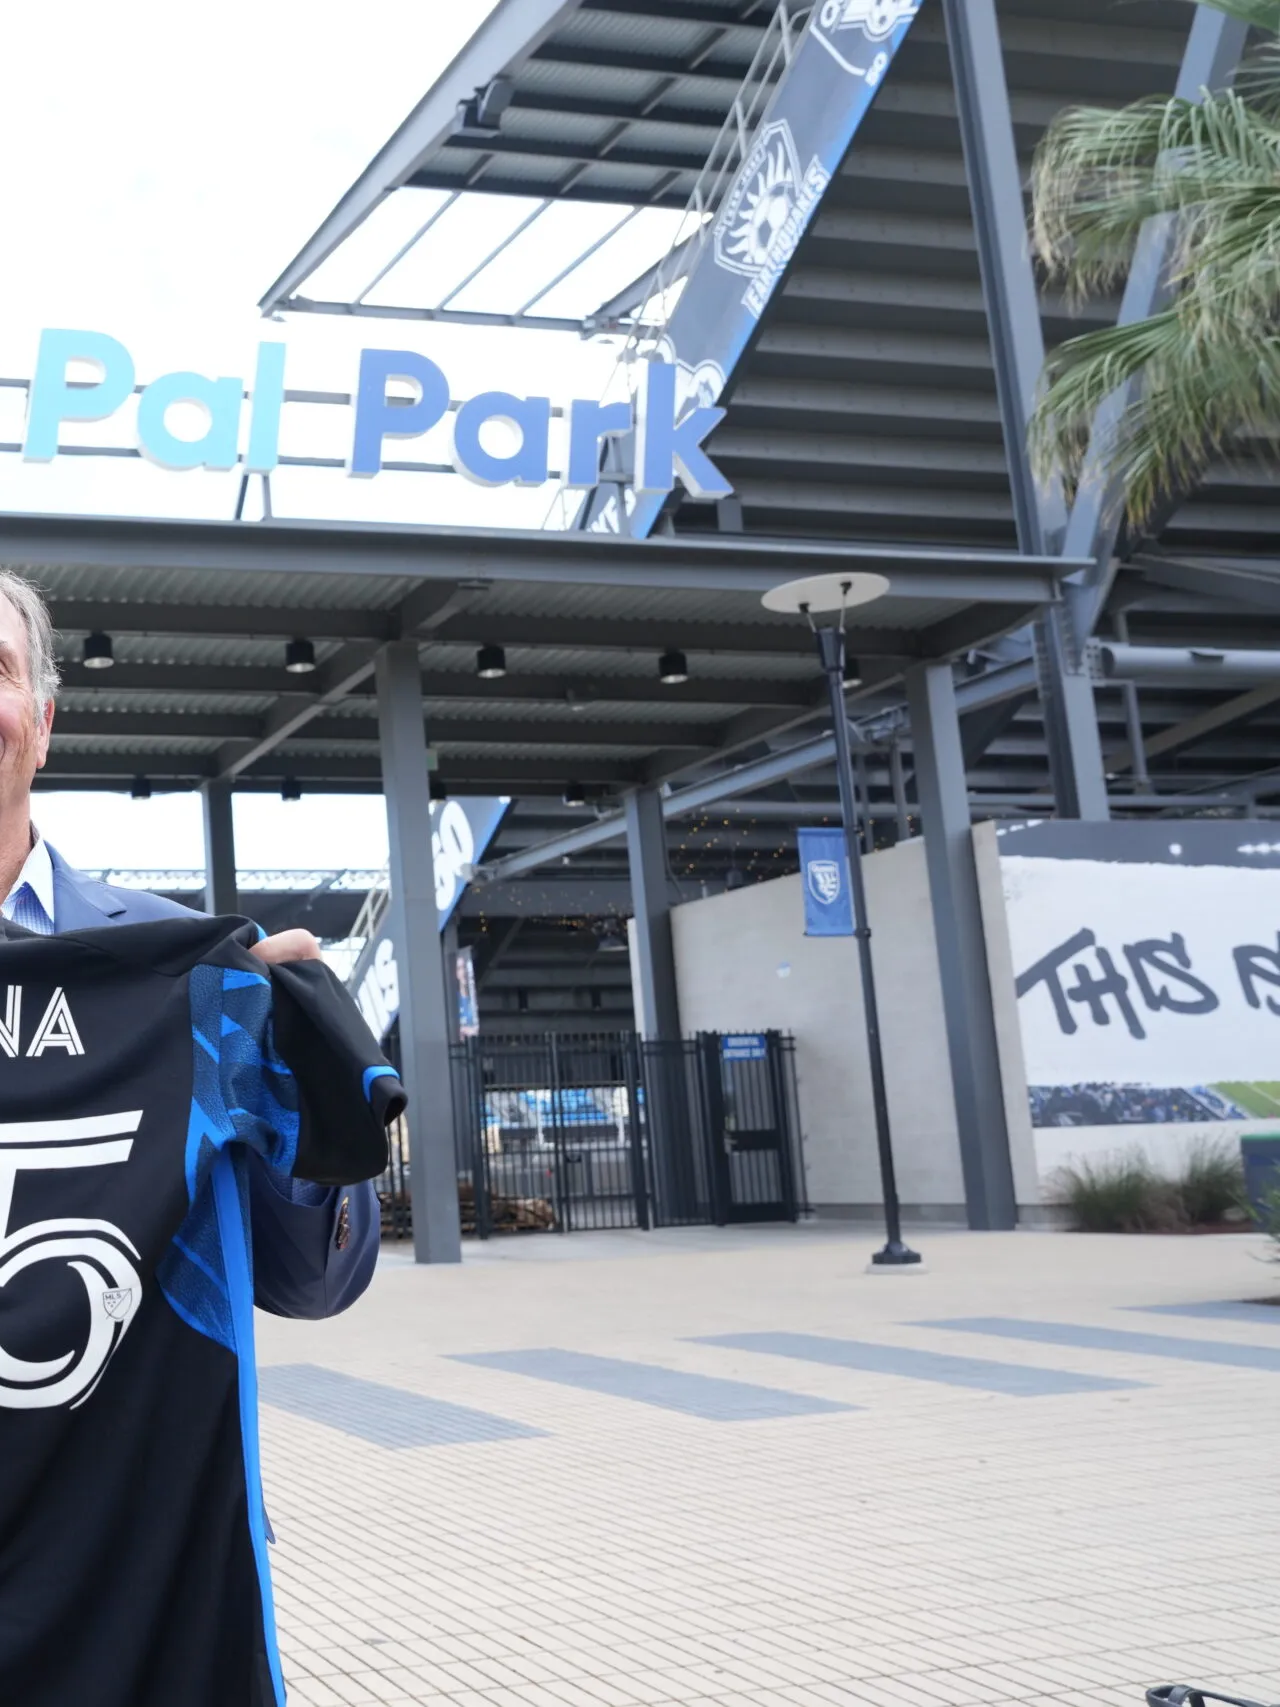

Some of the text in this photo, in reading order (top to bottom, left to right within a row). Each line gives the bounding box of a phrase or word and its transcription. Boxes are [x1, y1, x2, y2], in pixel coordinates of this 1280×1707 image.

[346, 347, 735, 499] Park
[1014, 927, 1220, 1040] THIS
[105, 1292, 121, 1300] MLS
